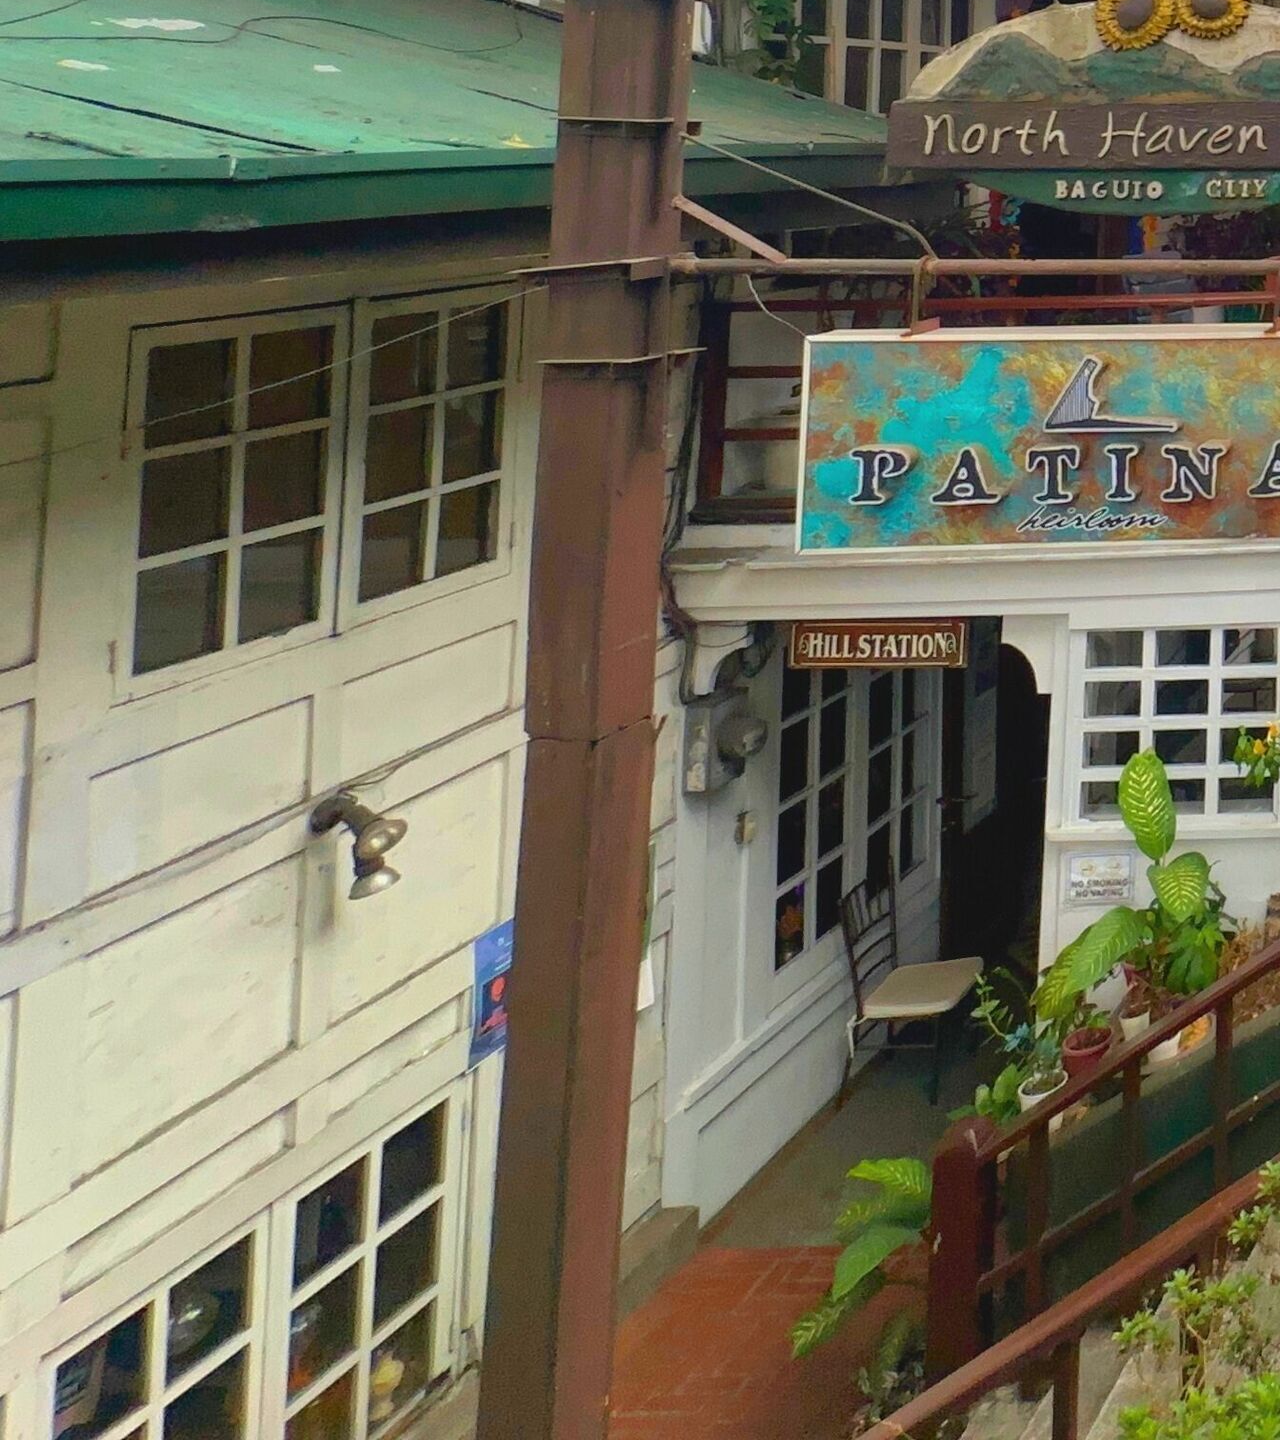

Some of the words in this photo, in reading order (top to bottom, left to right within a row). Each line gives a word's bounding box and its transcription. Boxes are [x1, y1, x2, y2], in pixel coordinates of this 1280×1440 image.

[923, 110, 1070, 157] North
[1097, 111, 1267, 159] Haven
[1054, 180, 1164, 200] BAGUIO
[1205, 179, 1268, 199] CITY
[1016, 505, 1168, 533] heirloom
[799, 632, 854, 659] HILL
[856, 632, 957, 659] STATION
[1071, 880, 1084, 888] NO
